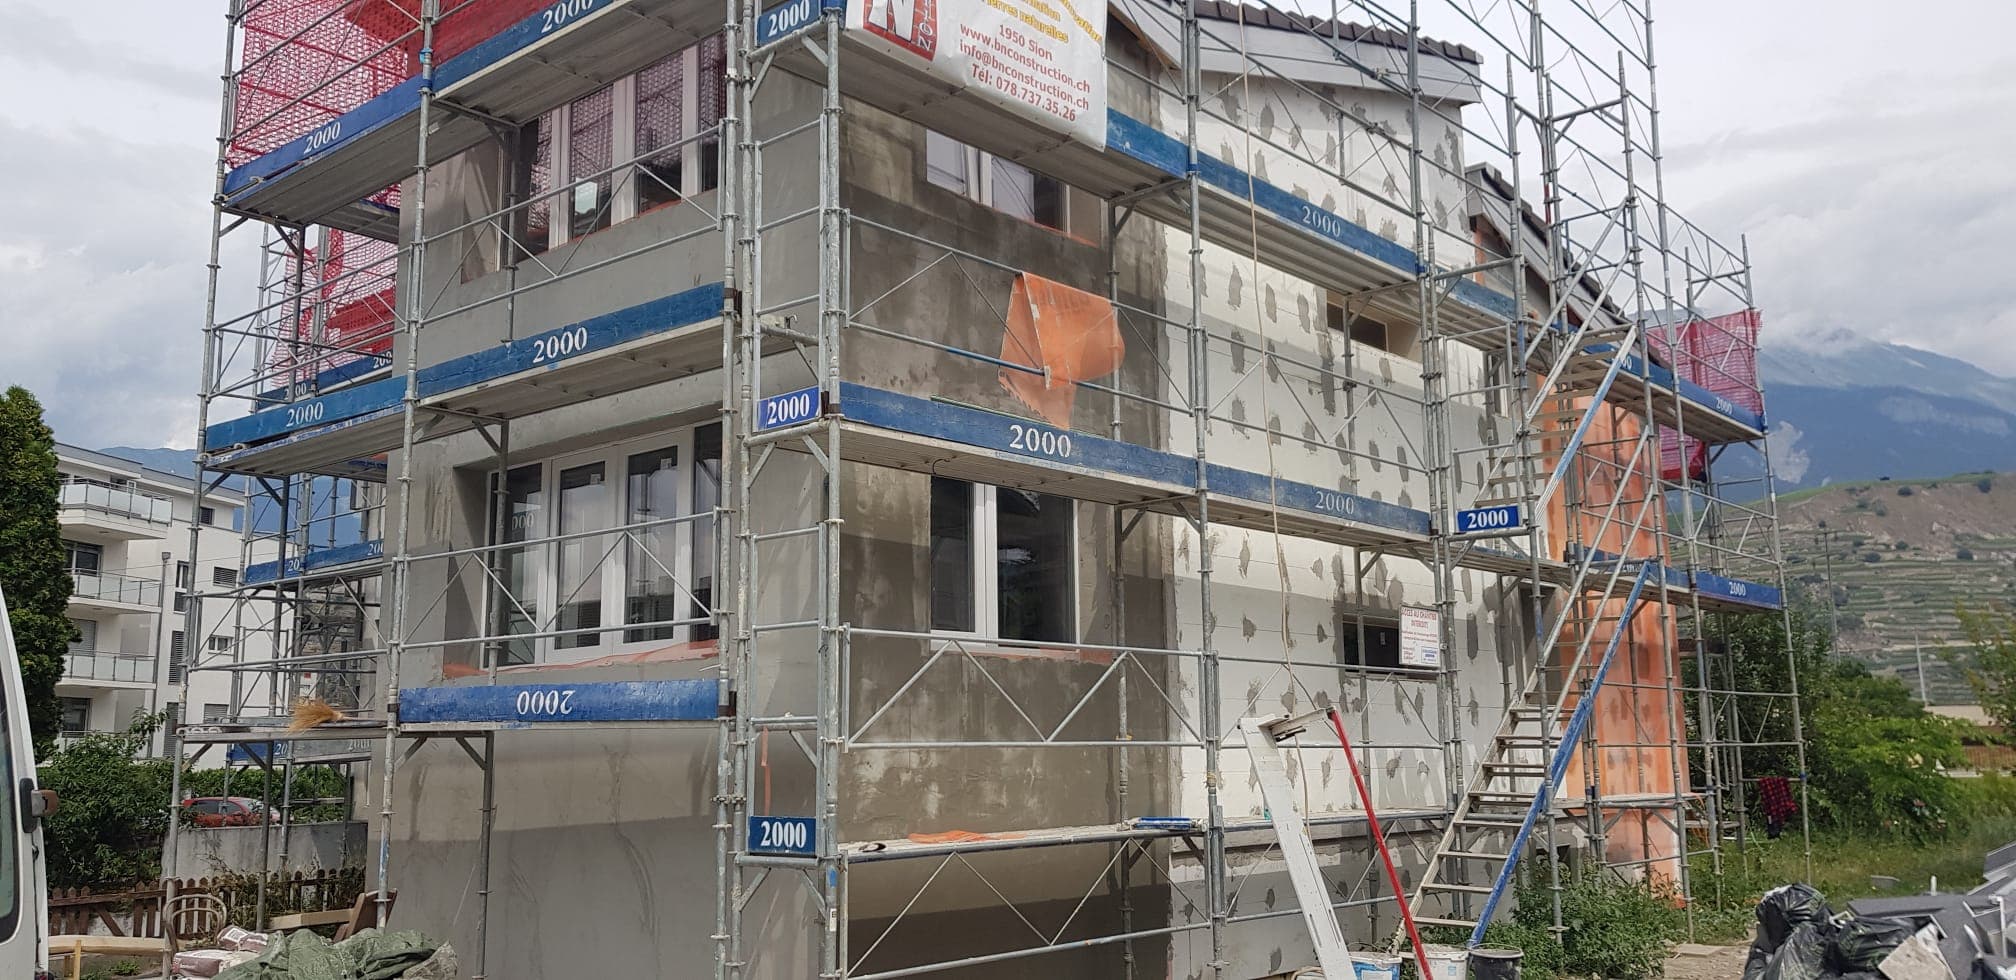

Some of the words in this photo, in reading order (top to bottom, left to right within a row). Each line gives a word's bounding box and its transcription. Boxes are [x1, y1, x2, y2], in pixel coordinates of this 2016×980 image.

[768, 0, 810, 37] 2000
[960, 24, 1090, 93] www.bnconstruction.ch
[999, 24, 1025, 47] 1950
[1028, 40, 1053, 61] Sion
[960, 39, 1089, 110] info@bnconstruction.ch
[972, 64, 992, 85] Tél:
[996, 76, 1076, 121] 078.737.35.26
[304, 122, 340, 154] 2000
[1301, 205, 1341, 238] 2000
[373, 350, 392, 369] 200
[533, 327, 588, 364] 2000
[283, 382, 307, 398] 200
[286, 401, 324, 427] 2000
[767, 393, 810, 425] 2000
[1009, 424, 1072, 458] 2000
[1315, 490, 1355, 516] 2000
[1467, 510, 1509, 529] 2000
[287, 558, 300, 572] 20
[1729, 581, 1747, 597] 2000
[517, 690, 576, 715] 2000
[760, 821, 807, 848] 2000
